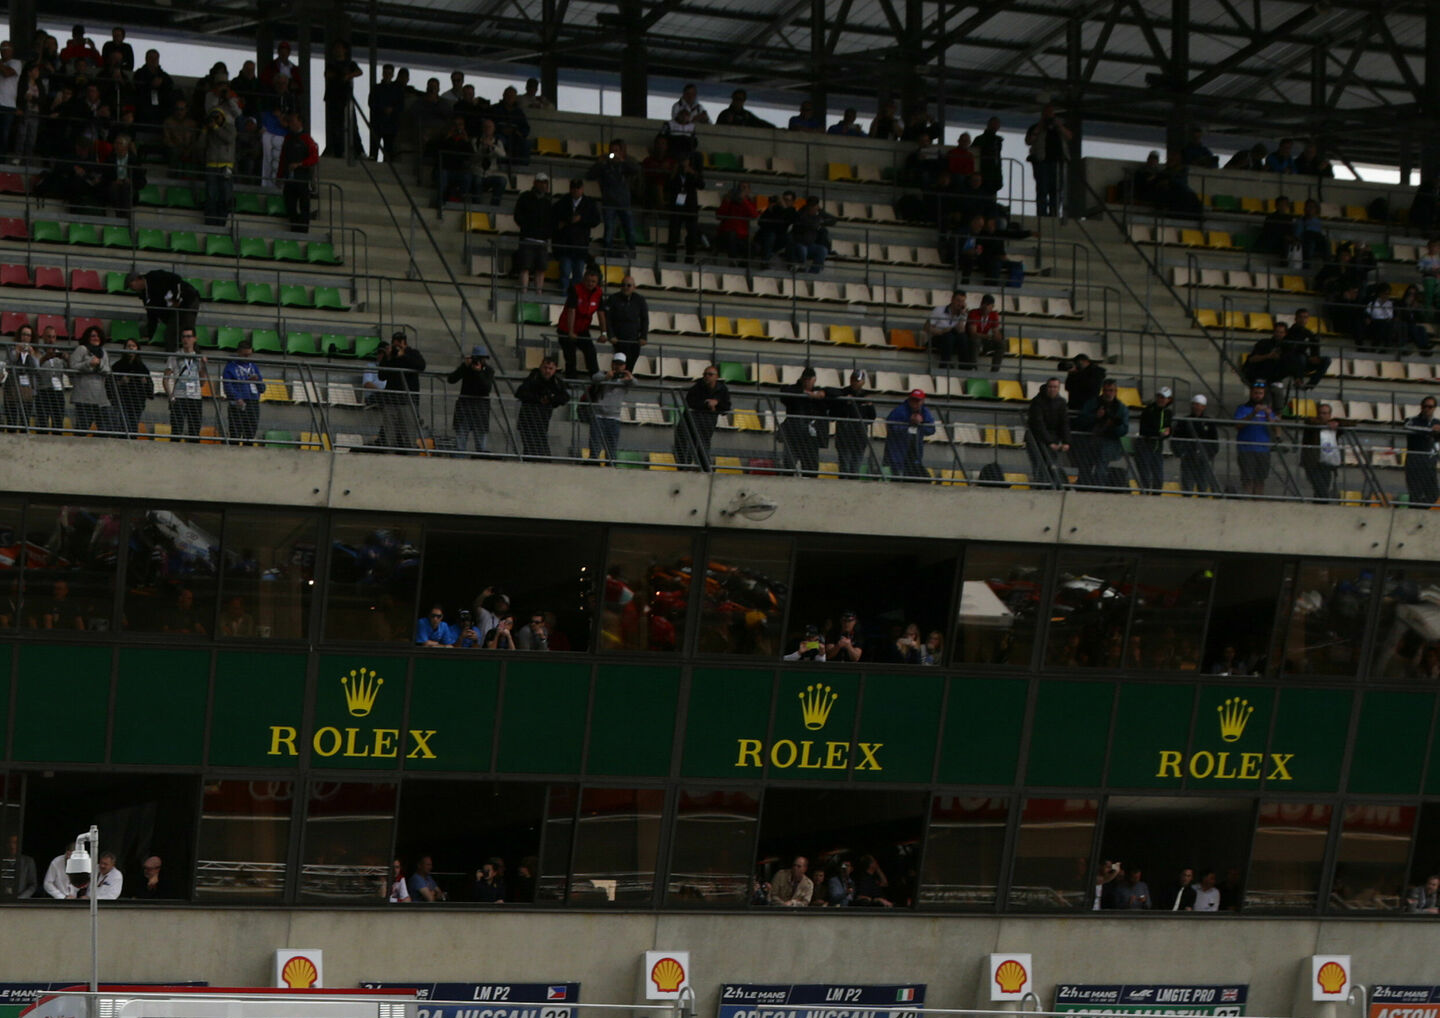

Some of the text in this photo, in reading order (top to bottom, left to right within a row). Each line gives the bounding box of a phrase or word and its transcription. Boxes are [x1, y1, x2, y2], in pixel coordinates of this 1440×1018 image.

[267, 725, 437, 759] ROLEX
[735, 739, 884, 771] ROLEX
[1156, 750, 1294, 780] ROLEX
[473, 986, 511, 1000] LM P2
[744, 991, 756, 999] LE
[757, 991, 786, 999] MANS
[826, 987, 844, 1001] LM
[845, 987, 862, 1001] P2
[1078, 990, 1091, 998] LE
[1091, 990, 1118, 999] MANS
[1156, 988, 1188, 1002] LMGTE
[1191, 988, 1215, 1002] PRO
[1392, 990, 1403, 998] LE
